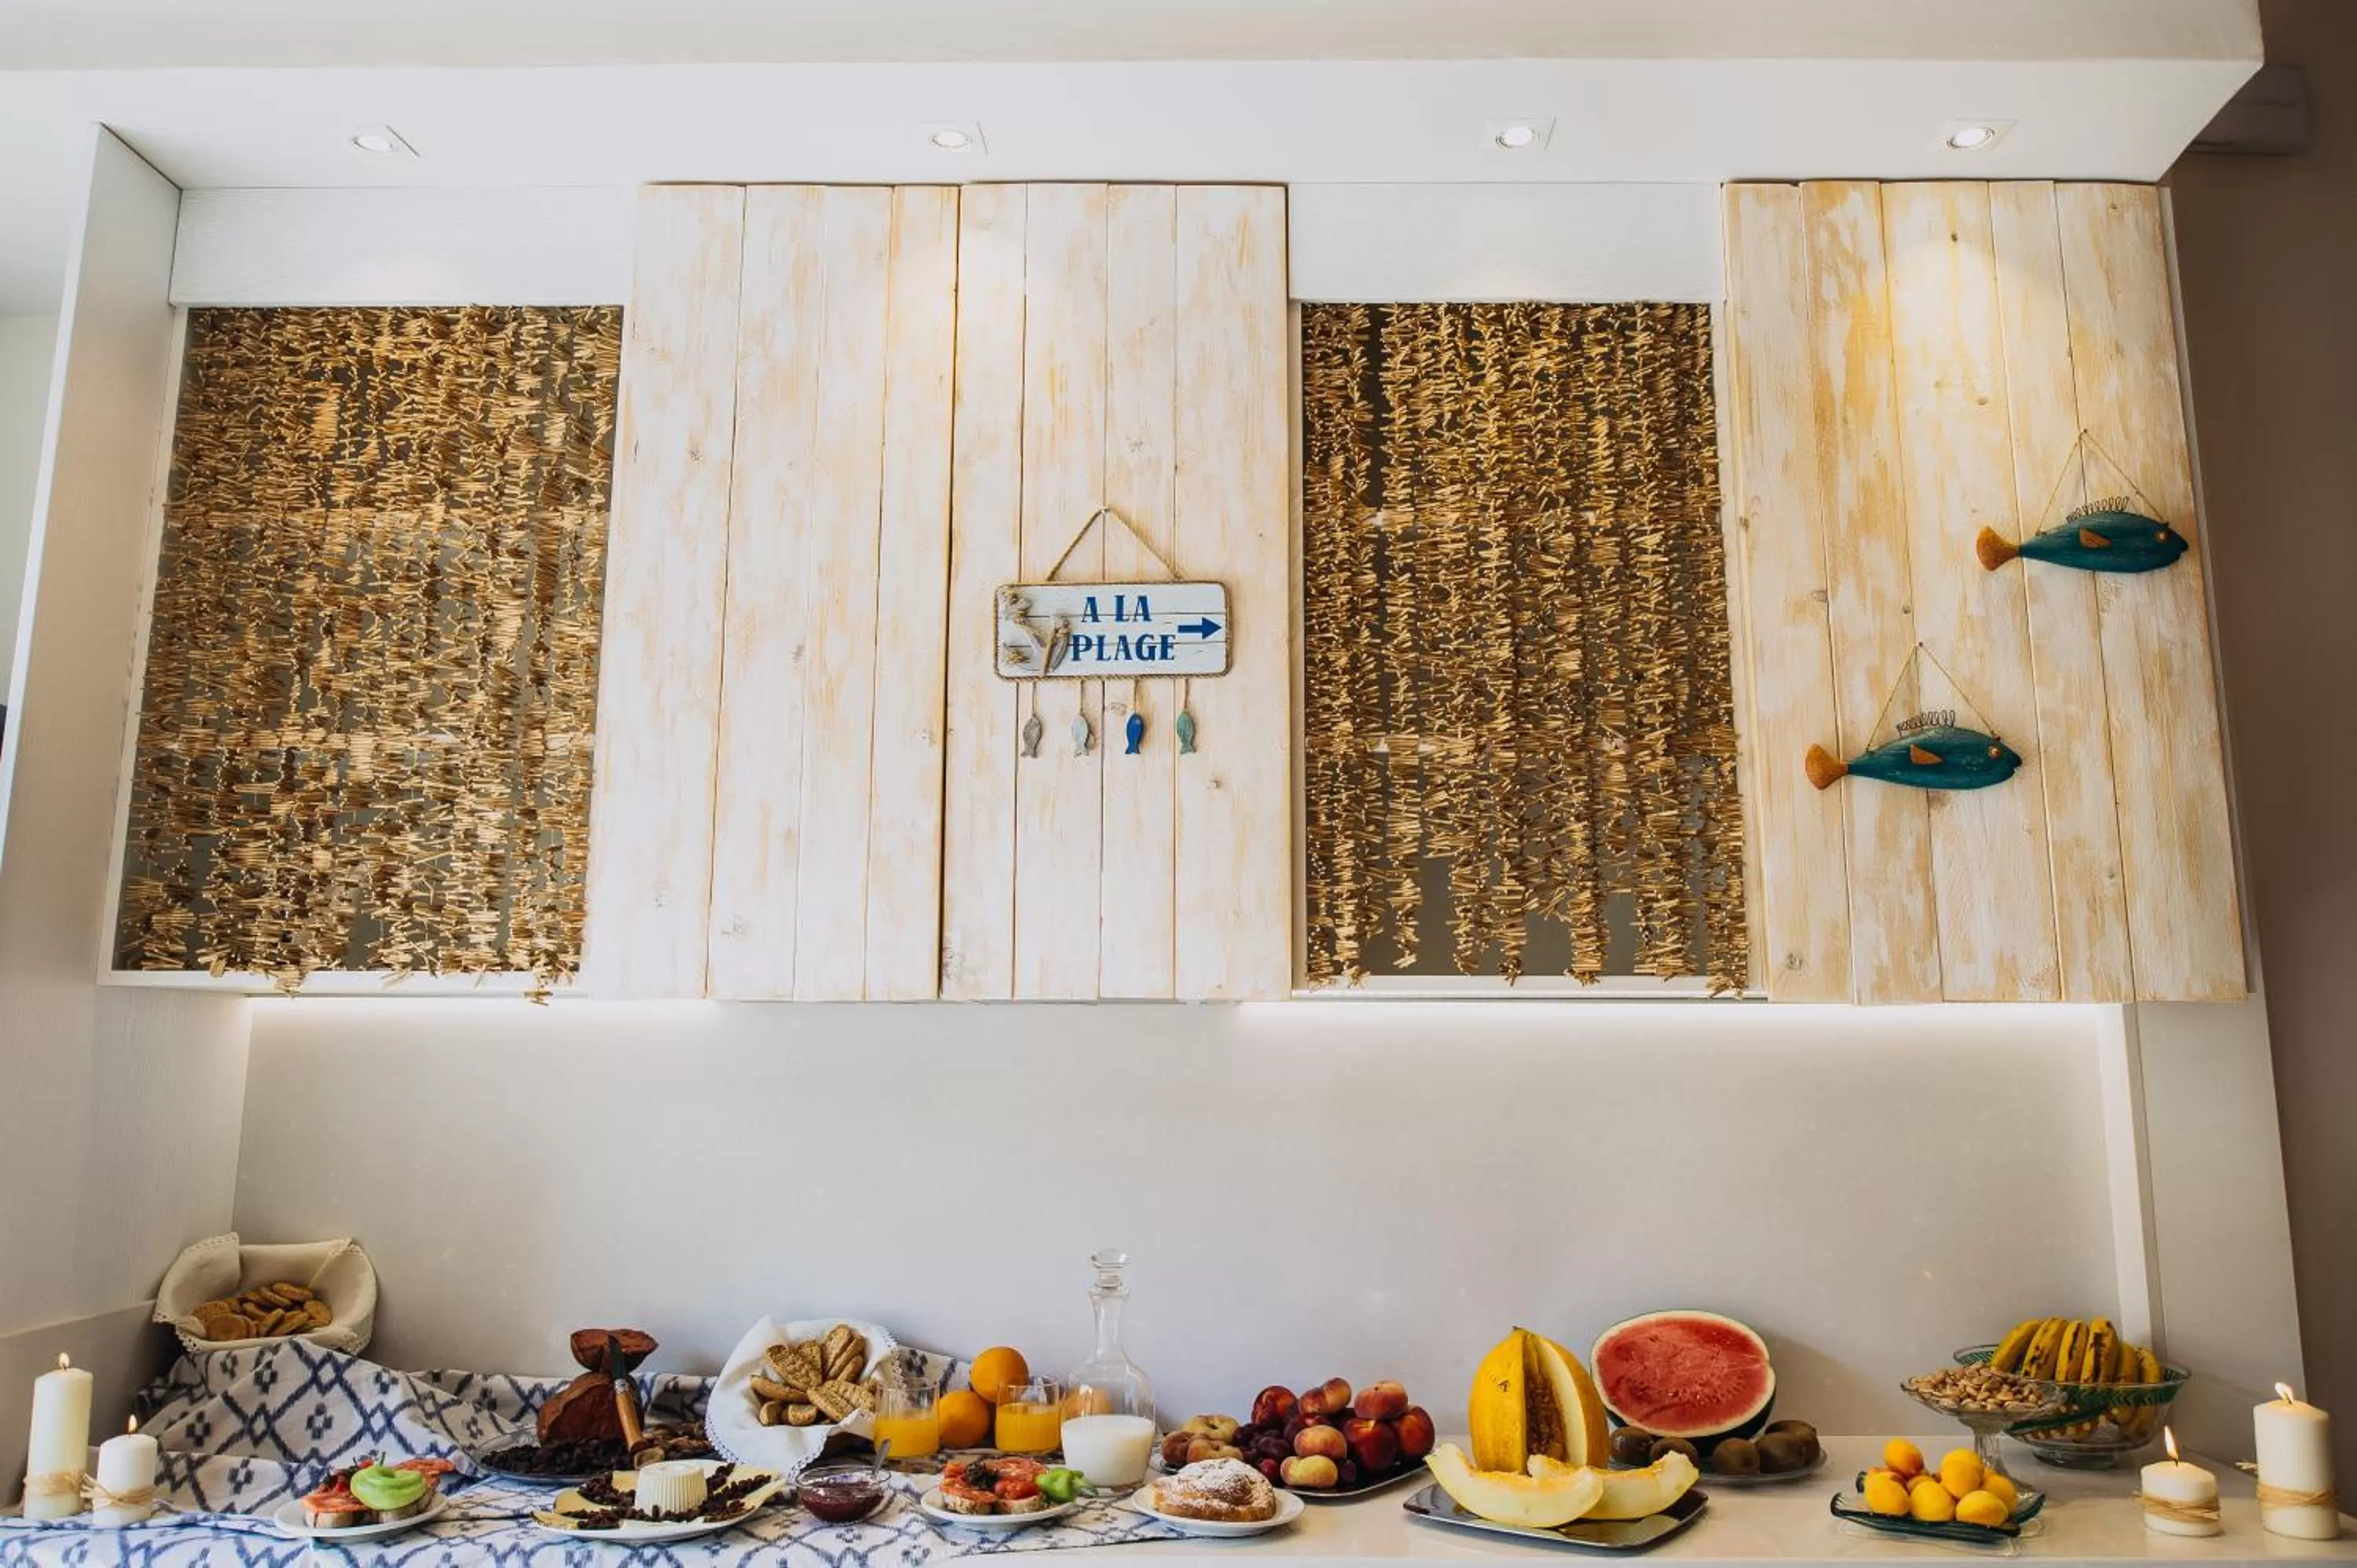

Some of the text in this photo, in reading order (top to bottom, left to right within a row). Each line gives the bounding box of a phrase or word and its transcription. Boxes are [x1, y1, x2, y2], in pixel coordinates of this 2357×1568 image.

[1081, 595, 1152, 623] A LA
[1071, 634, 1176, 661] PLAGE
